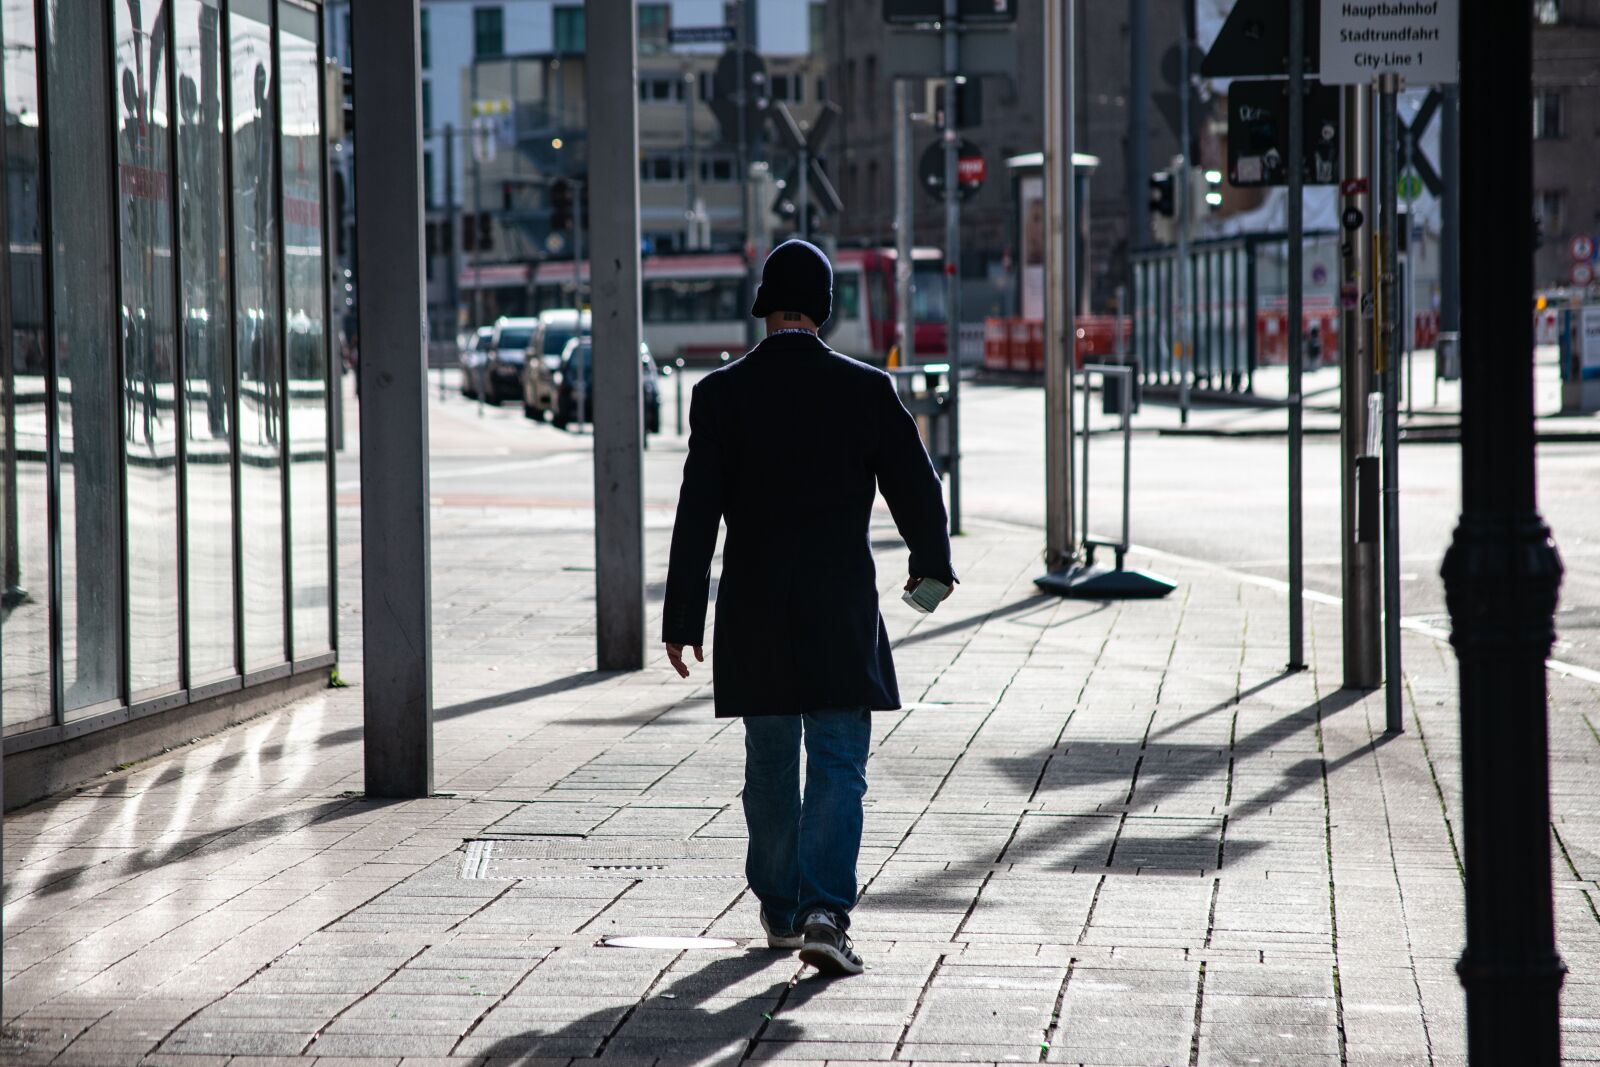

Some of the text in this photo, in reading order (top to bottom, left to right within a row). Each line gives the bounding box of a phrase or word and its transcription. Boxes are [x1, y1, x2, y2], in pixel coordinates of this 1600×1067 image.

[1342, 1, 1438, 19] Hauptbahnhof
[1340, 27, 1439, 42] Stadtrundfahrt
[1417, 52, 1423, 65] 1
